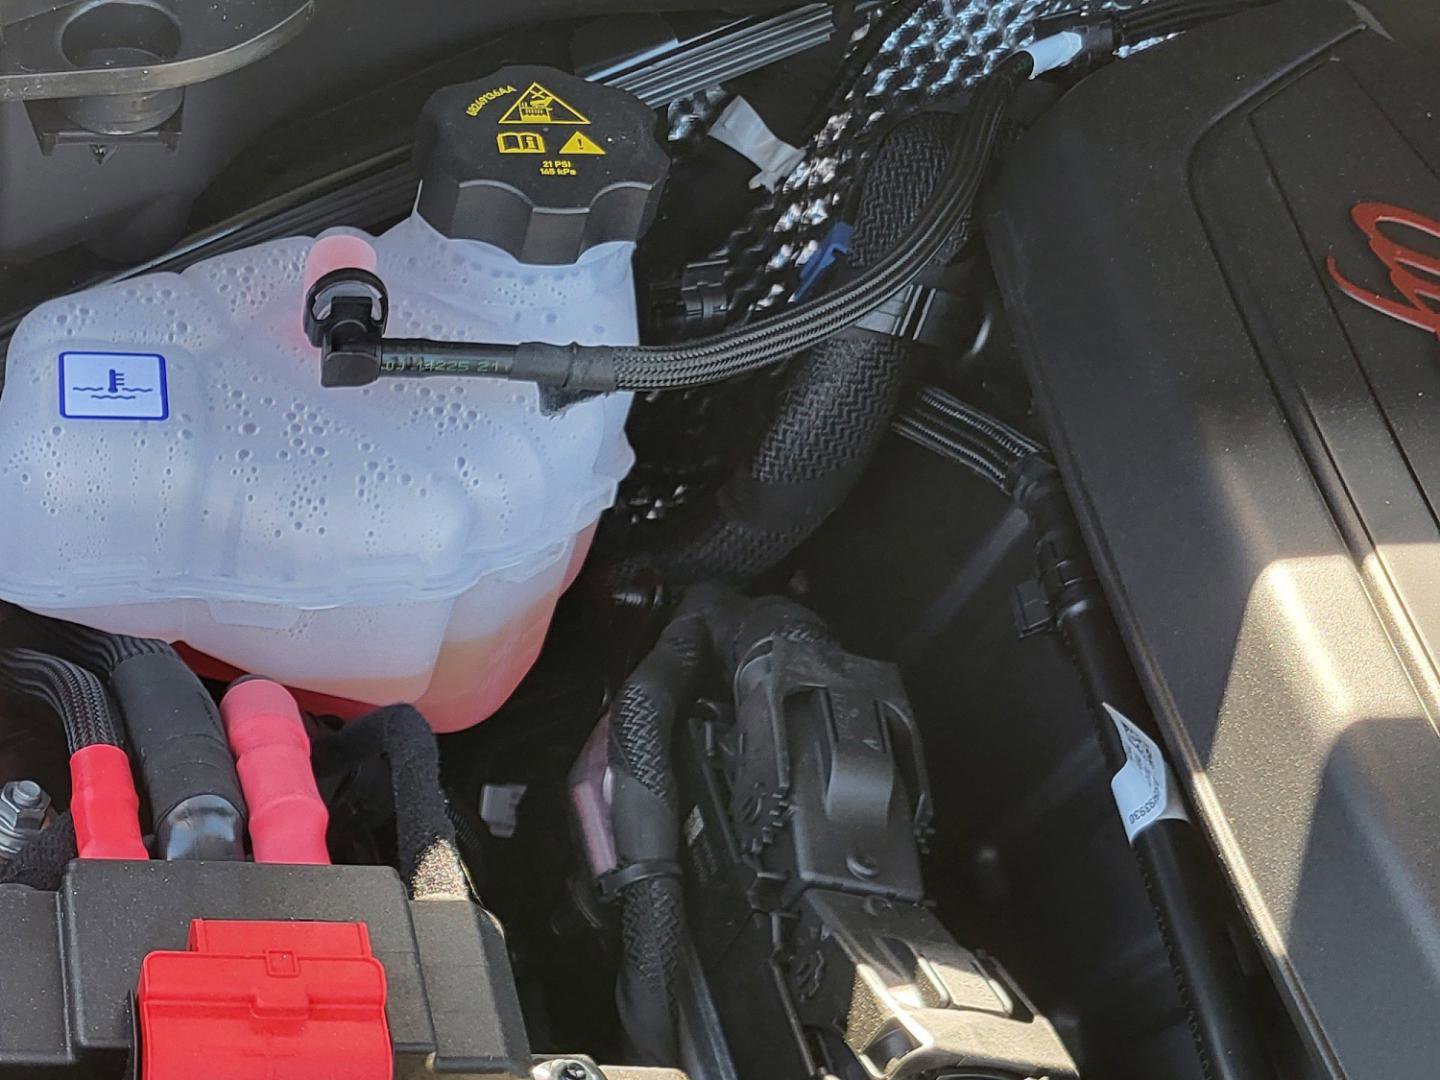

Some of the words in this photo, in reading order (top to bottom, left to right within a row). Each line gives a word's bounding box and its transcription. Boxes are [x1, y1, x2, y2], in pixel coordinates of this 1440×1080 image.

[542, 160, 553, 168] 21
[554, 160, 571, 168] PSI
[539, 167, 556, 176] 145
[557, 167, 577, 176] kPa
